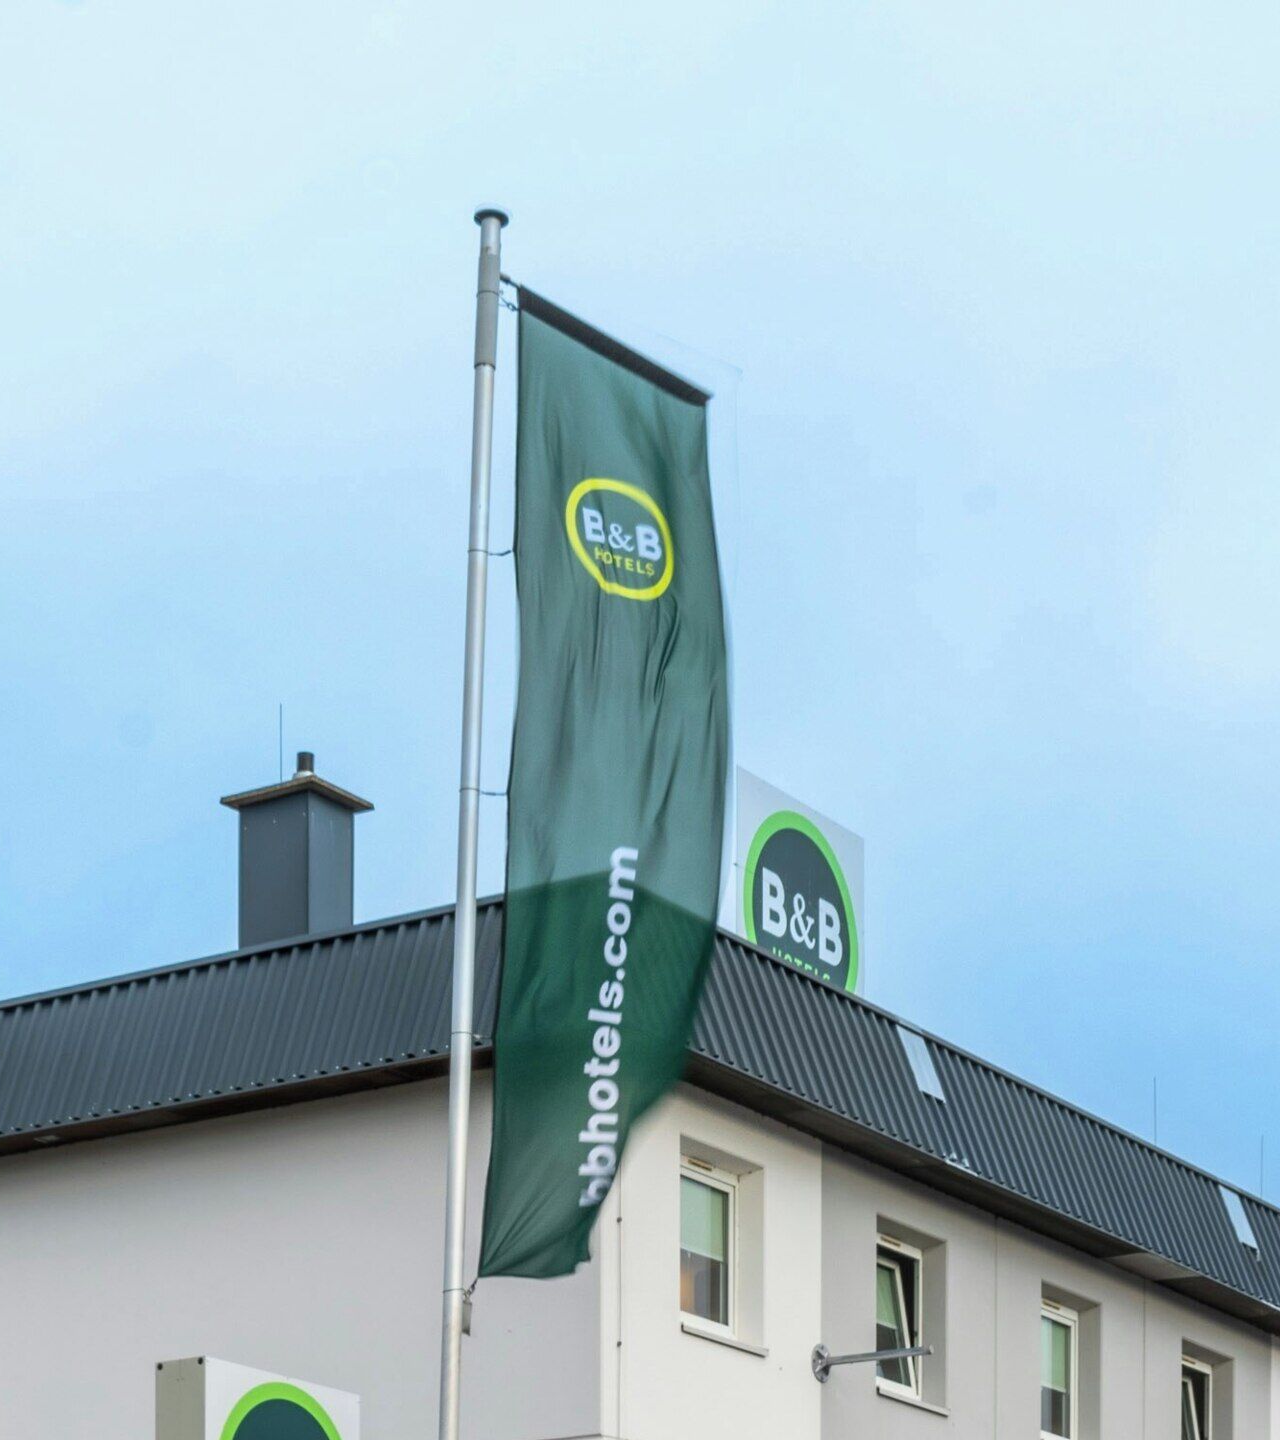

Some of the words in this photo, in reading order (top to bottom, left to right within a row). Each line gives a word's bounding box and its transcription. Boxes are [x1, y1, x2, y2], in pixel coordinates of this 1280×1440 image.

[582, 506, 663, 562] B&B
[594, 546, 655, 577] HOTELS
[762, 866, 843, 967] B&B
